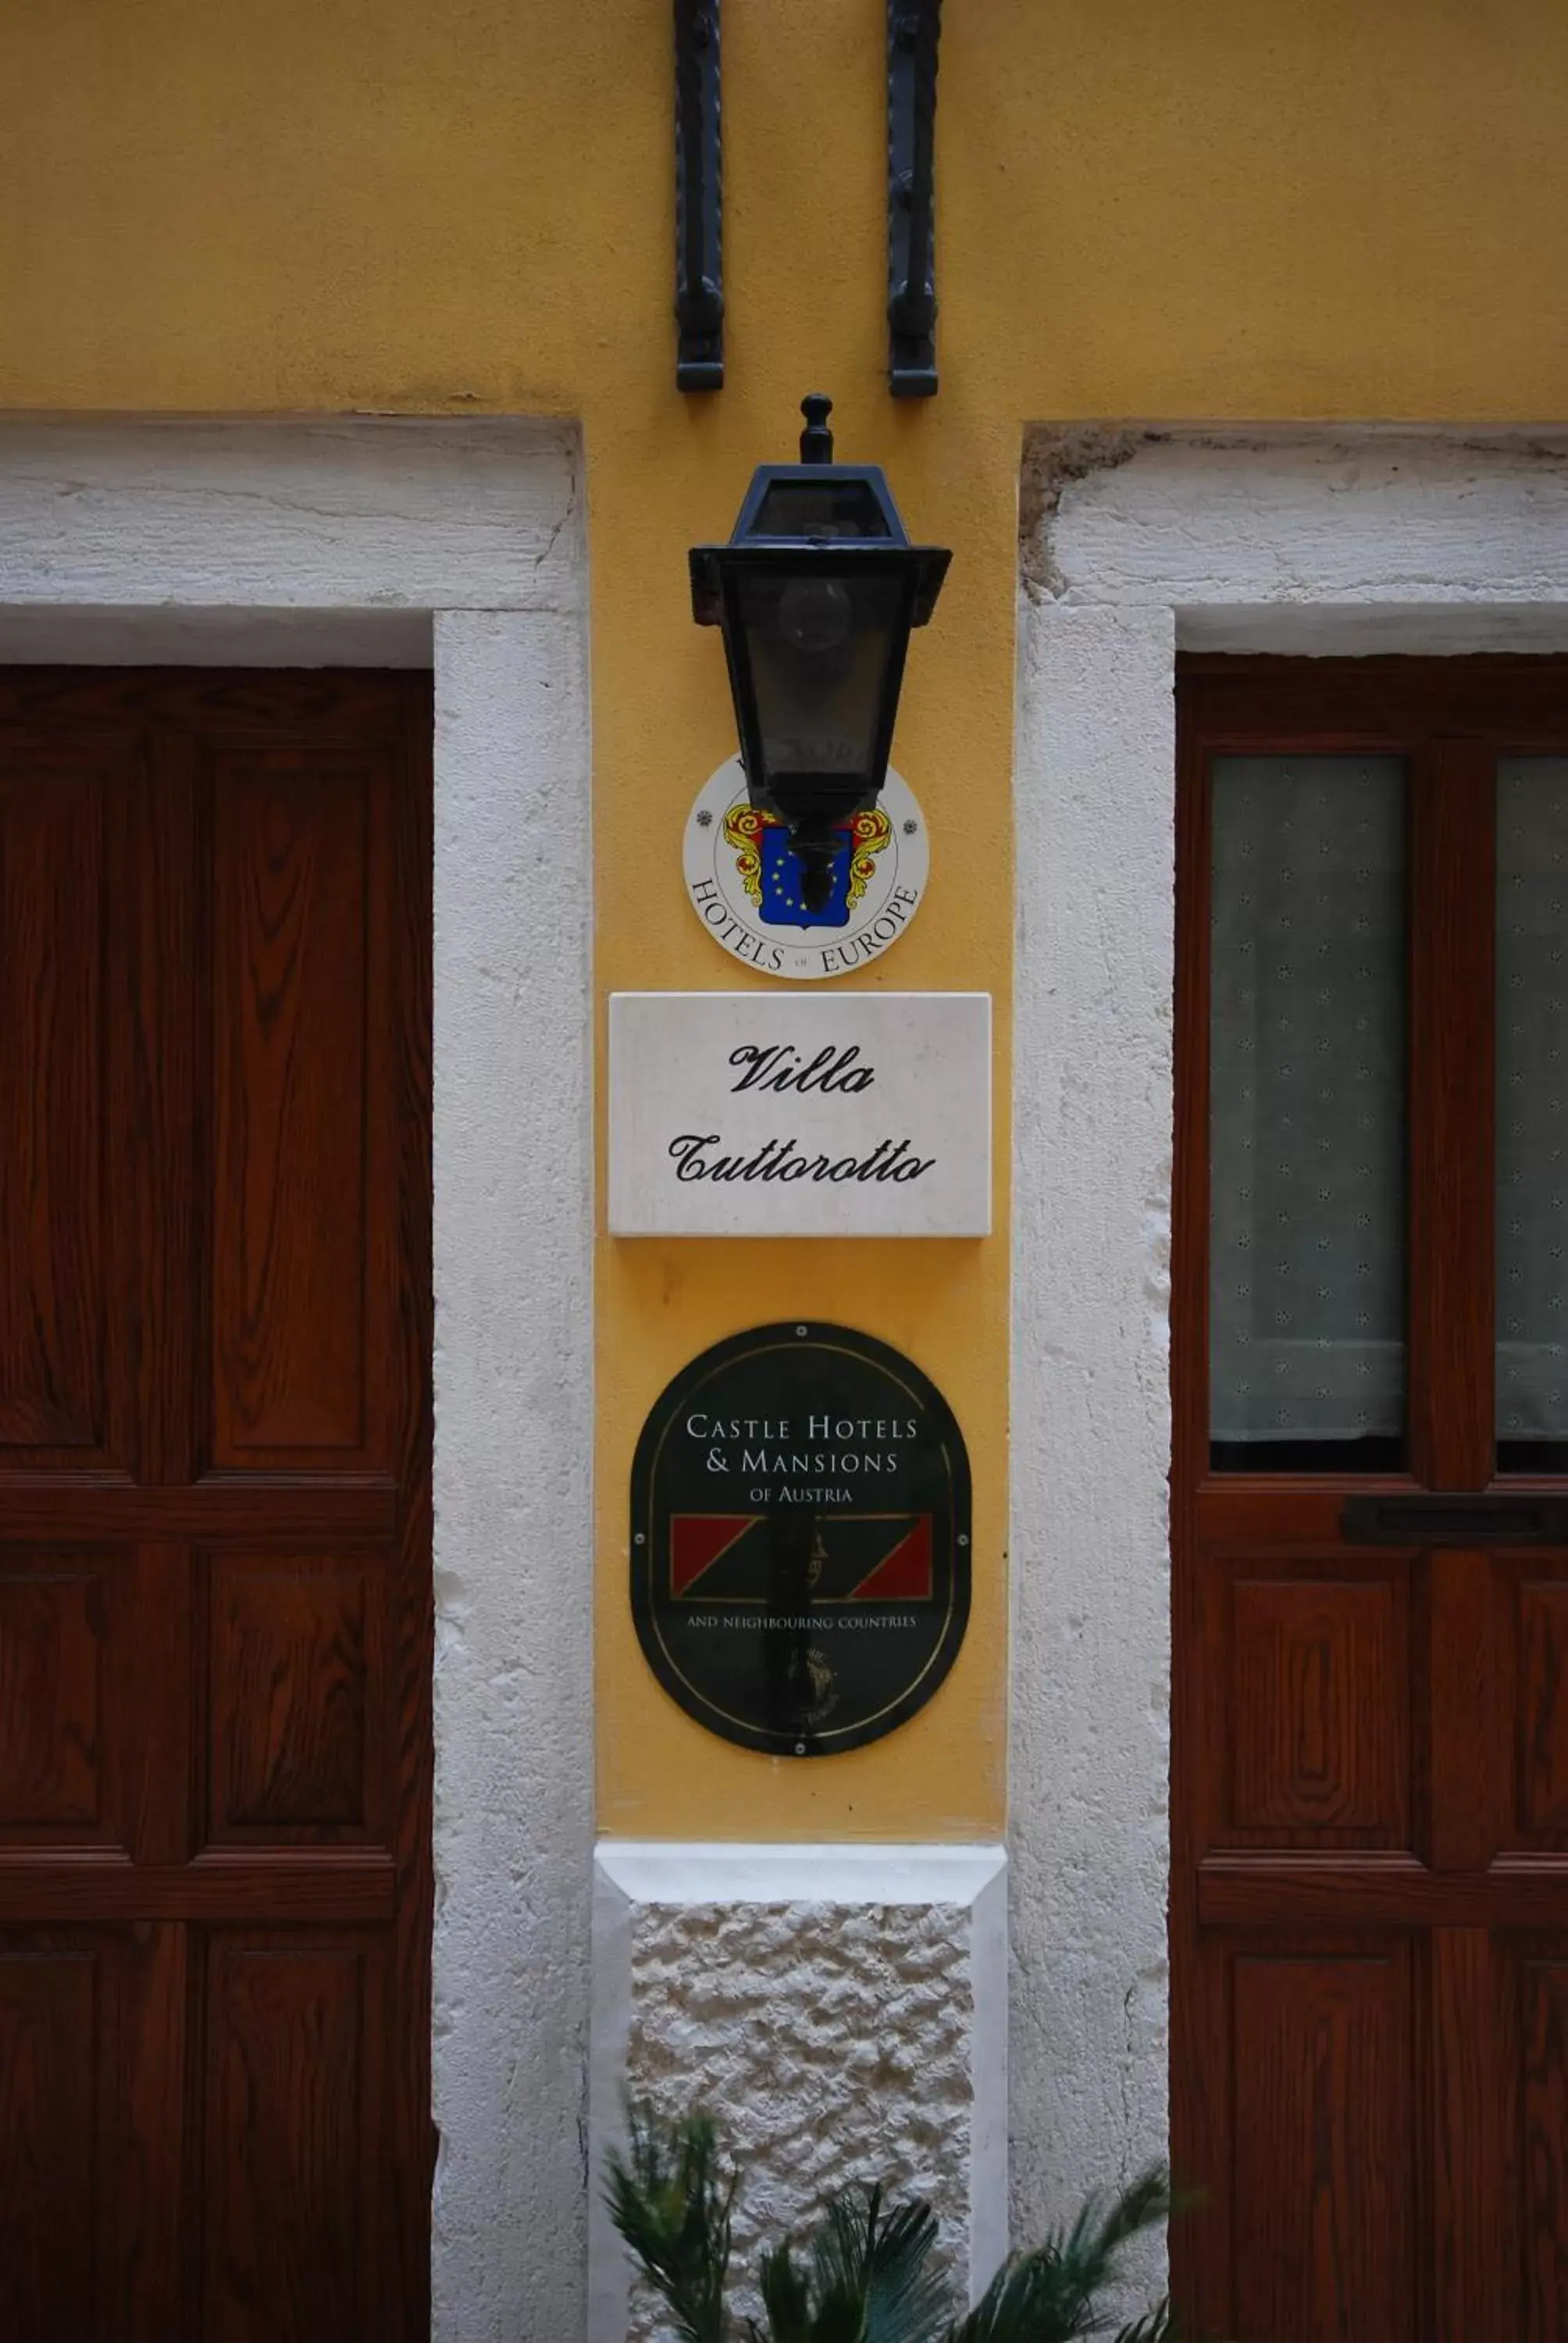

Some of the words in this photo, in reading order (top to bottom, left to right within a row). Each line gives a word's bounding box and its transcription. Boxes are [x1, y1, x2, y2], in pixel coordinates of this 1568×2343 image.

[692, 879, 785, 971] HOTELS
[820, 886, 918, 972] EUROPE
[729, 1044, 875, 1093] Villa
[668, 1134, 936, 1183] Tuttorotto
[686, 1414, 790, 1439] CASTLE
[808, 1414, 917, 1439] HOTELS
[706, 1447, 730, 1473] &
[742, 1449, 897, 1473] MANSIONS
[750, 1488, 772, 1503] OF
[779, 1486, 853, 1503] AUSTRIA
[687, 1615, 718, 1628] AND
[723, 1616, 834, 1630] NEIGHBOURING
[838, 1615, 917, 1629] COUNTRIES
